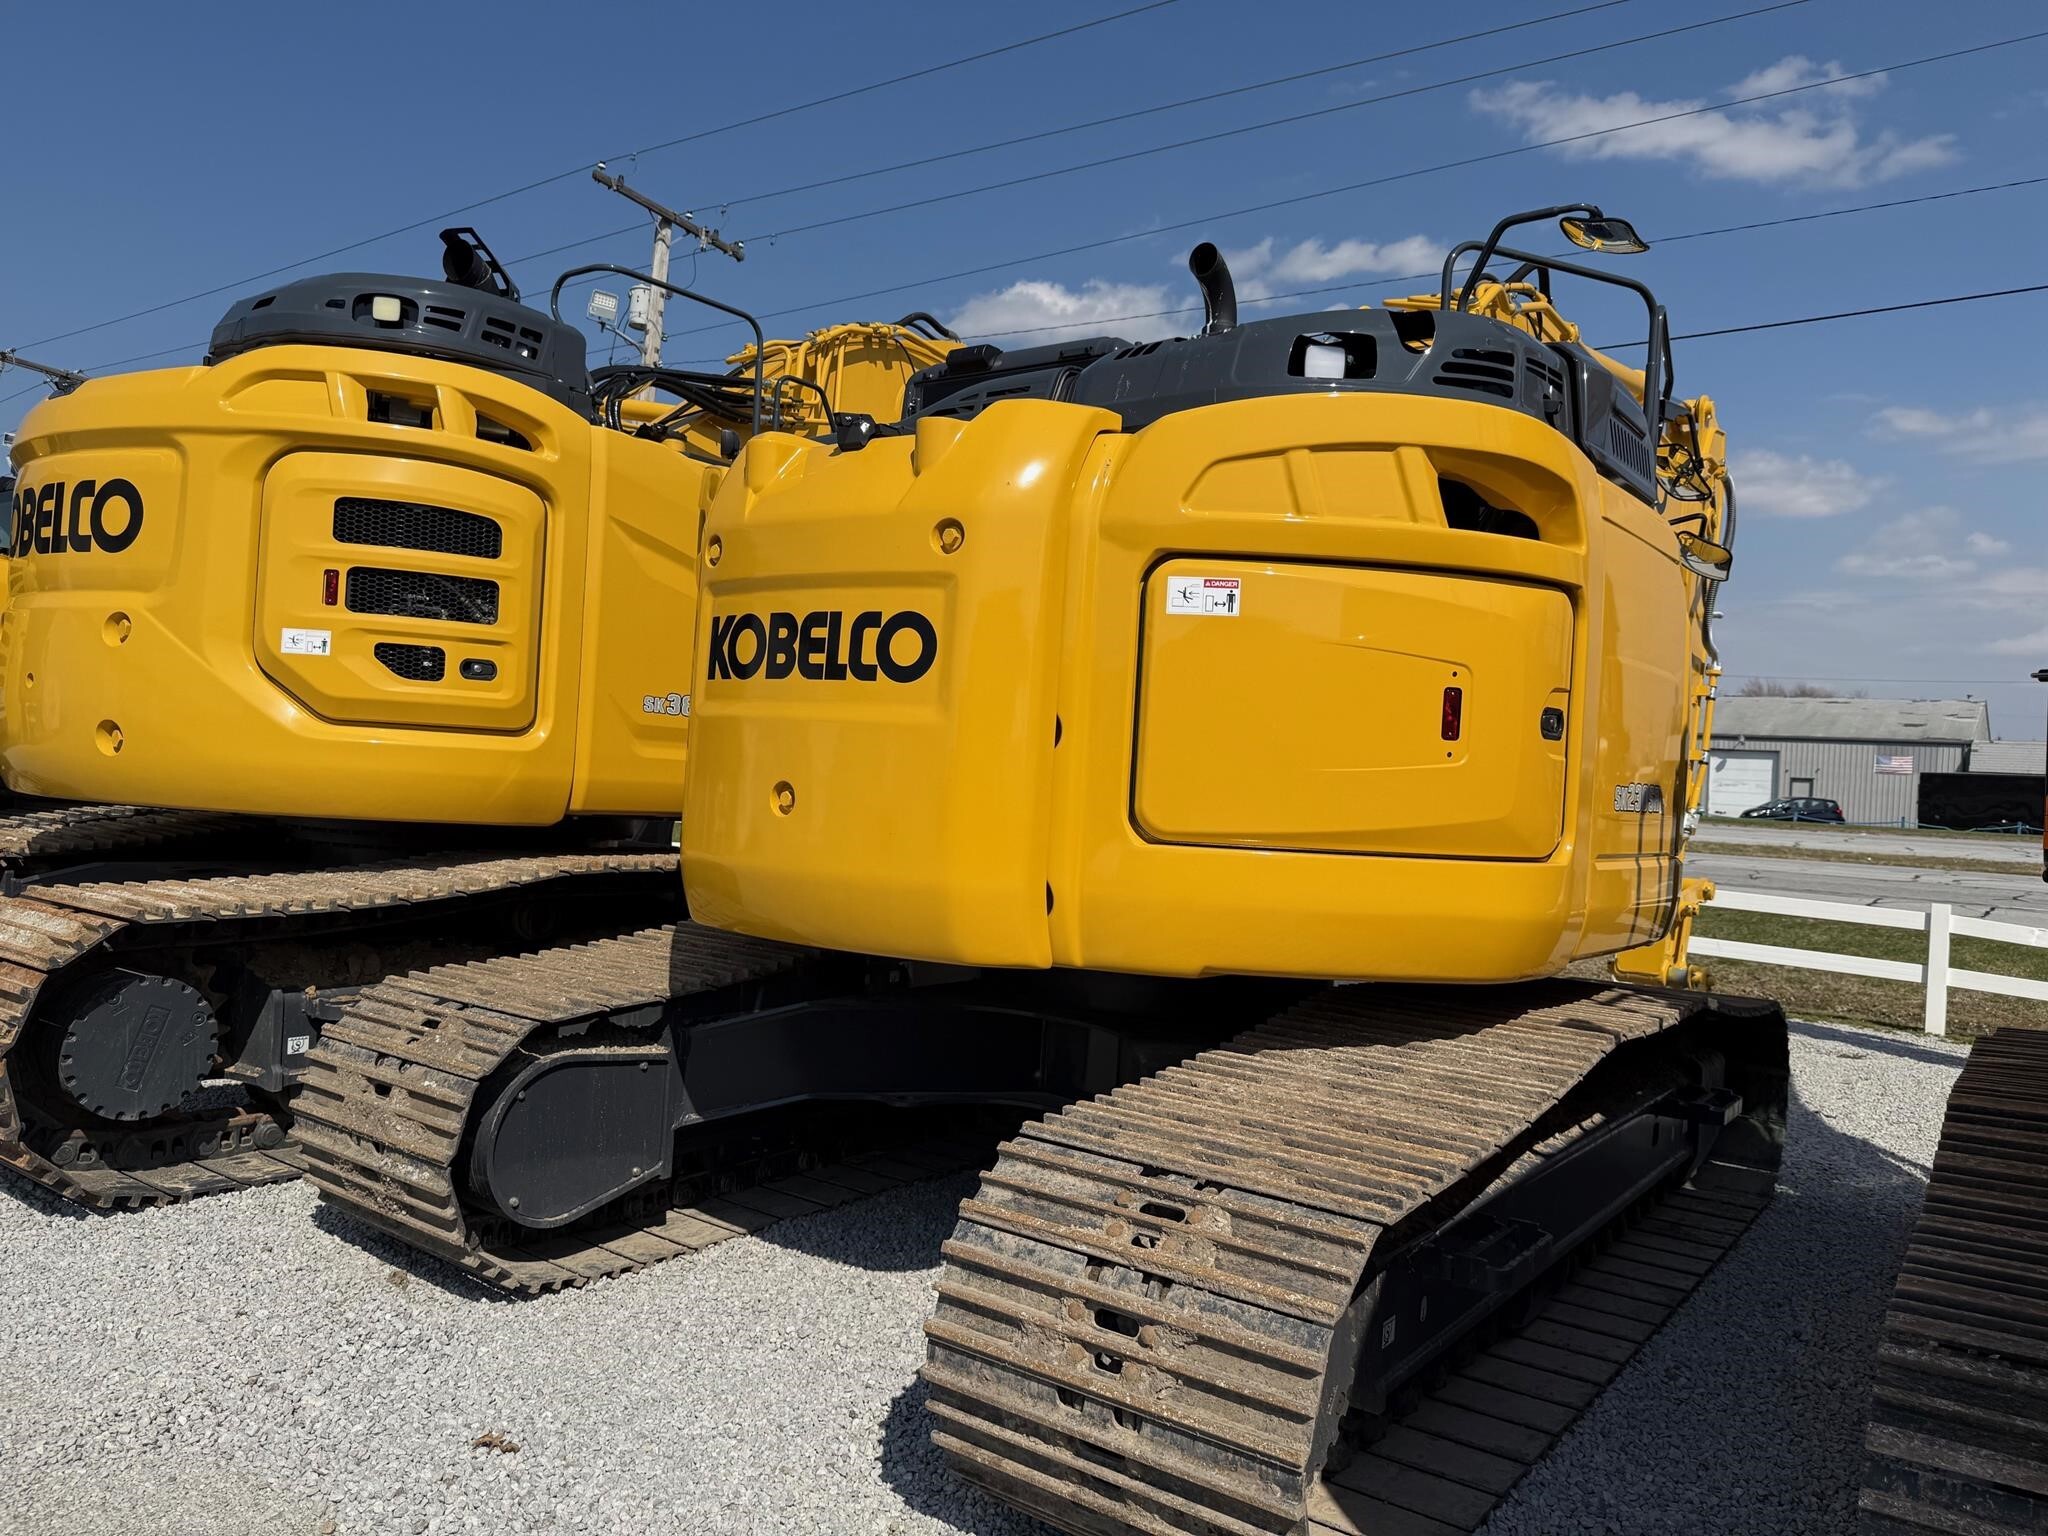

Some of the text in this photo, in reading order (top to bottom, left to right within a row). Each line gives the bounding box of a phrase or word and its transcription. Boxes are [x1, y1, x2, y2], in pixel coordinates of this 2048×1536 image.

[10, 478, 144, 558] OBELCO
[1211, 580, 1238, 588] DANGER
[707, 610, 938, 683] KOBELCO
